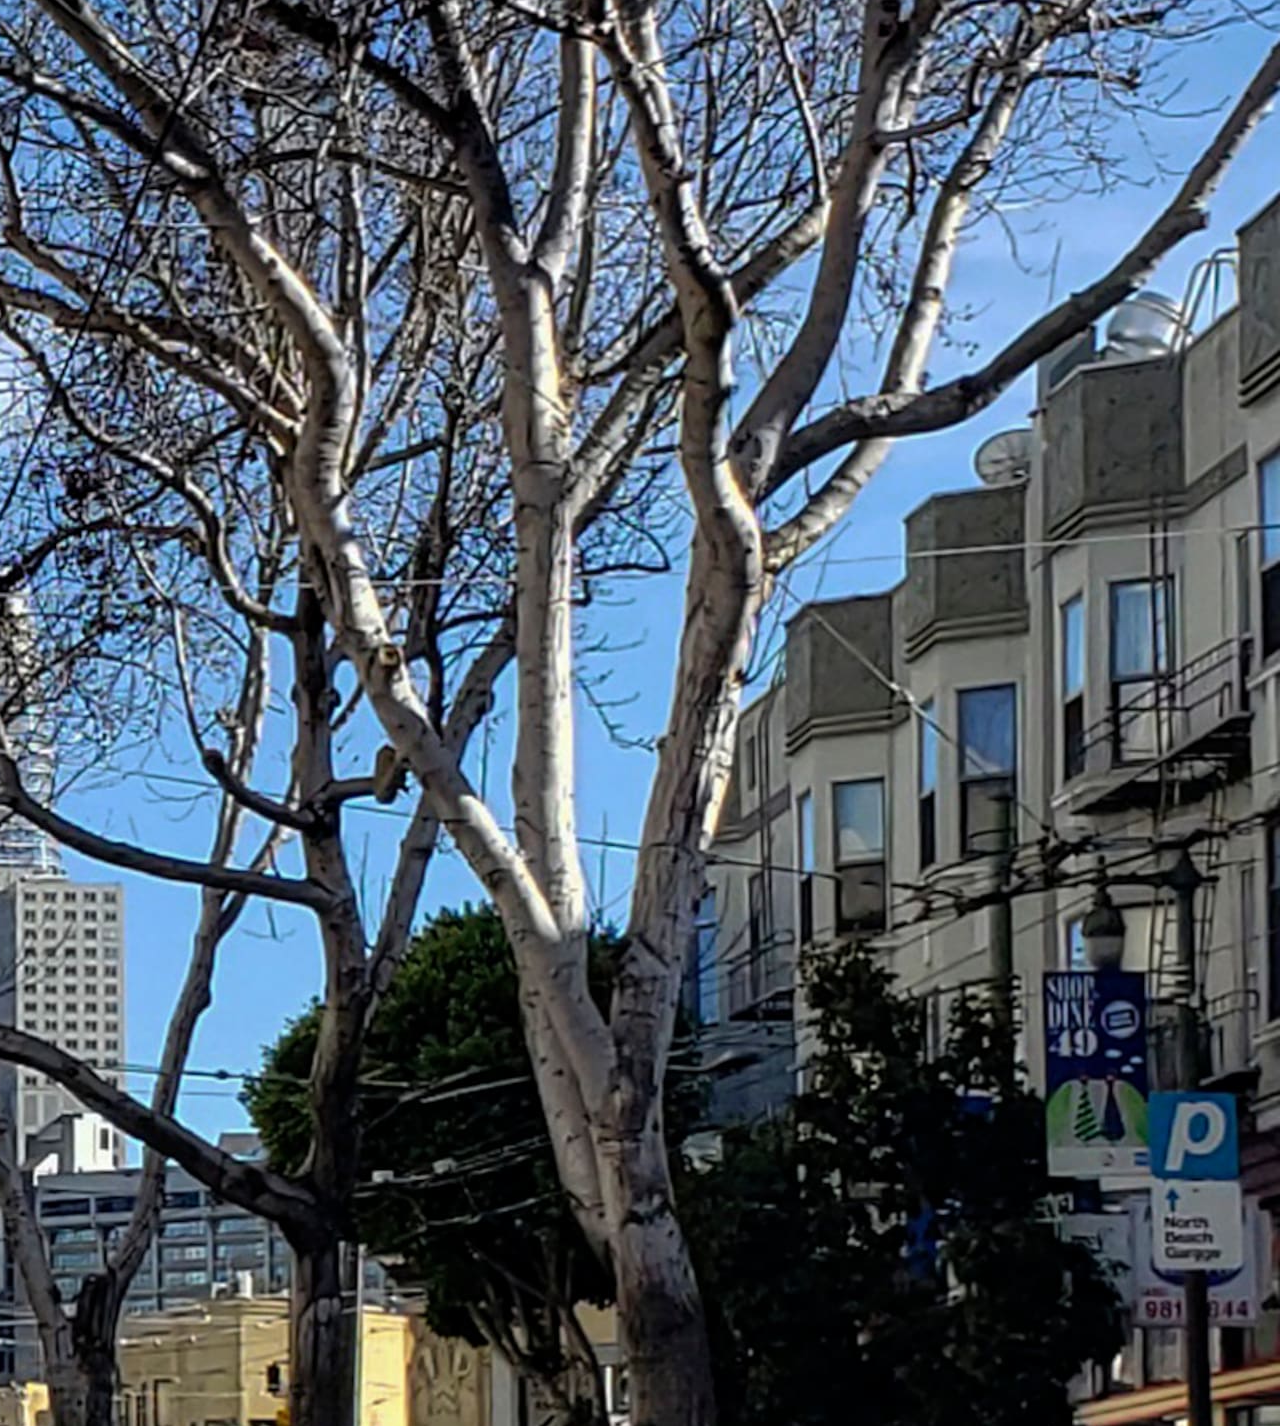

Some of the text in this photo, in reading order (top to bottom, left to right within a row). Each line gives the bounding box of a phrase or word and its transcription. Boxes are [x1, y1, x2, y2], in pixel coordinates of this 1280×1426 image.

[1048, 1001, 1096, 1028] DINE
[1048, 1029, 1098, 1056] 49
[1164, 1100, 1226, 1171] P
[1164, 1216, 1209, 1229] North
[1164, 1231, 1214, 1244] Beach
[1164, 1246, 1222, 1262] Garage
[1145, 1299, 1183, 1318] 981
